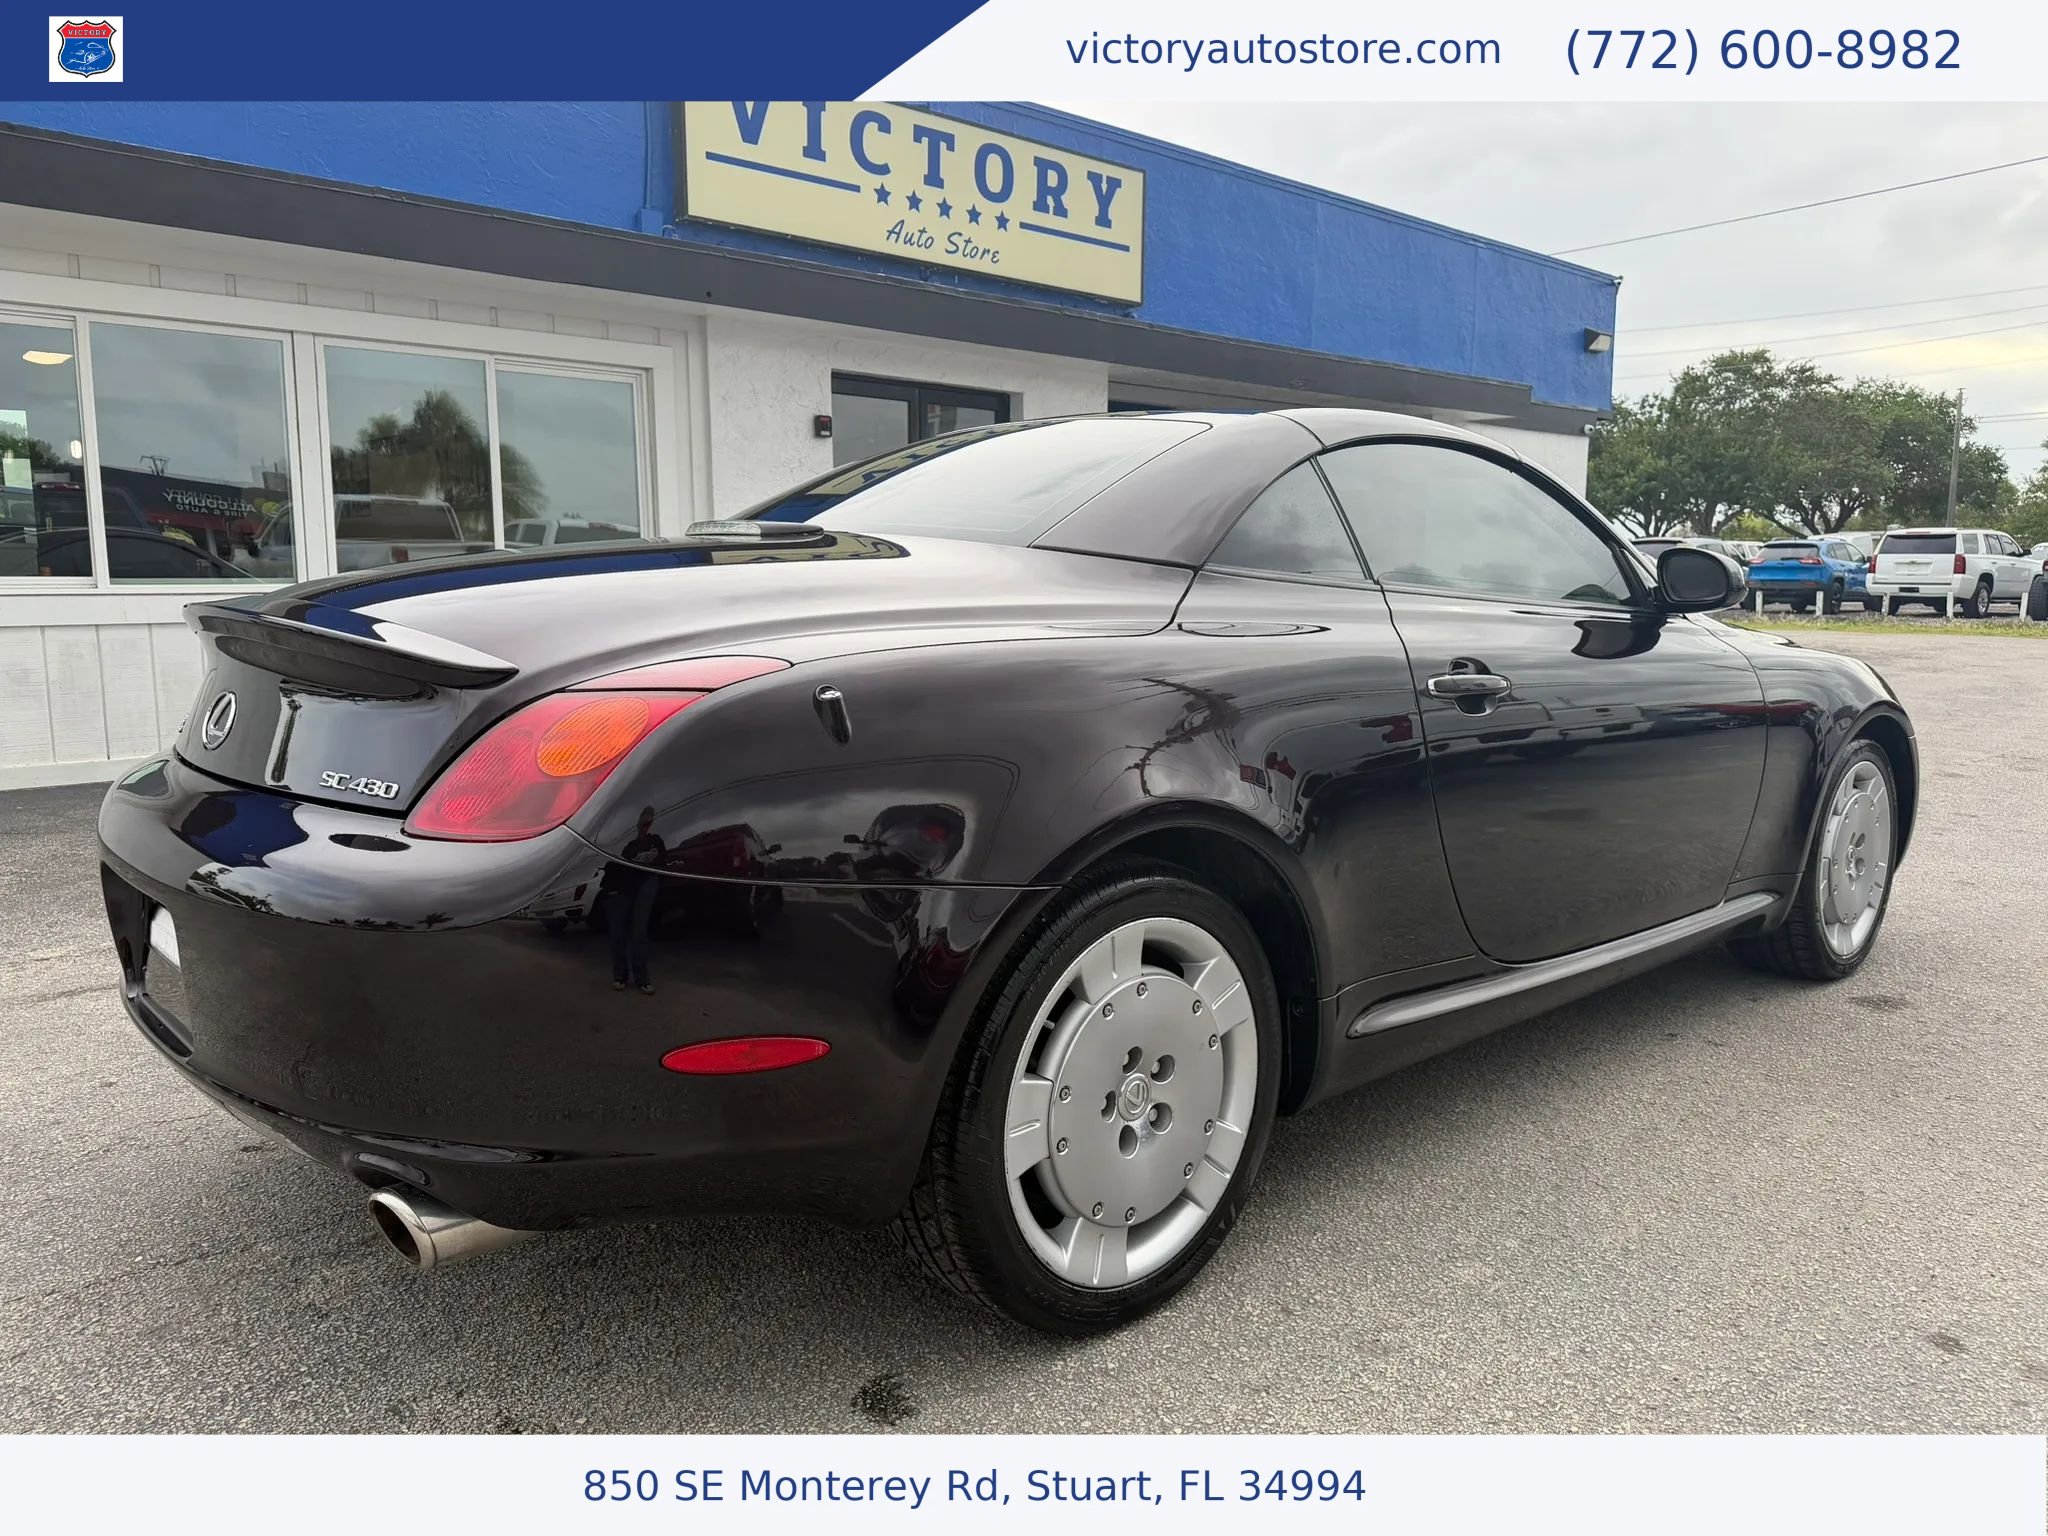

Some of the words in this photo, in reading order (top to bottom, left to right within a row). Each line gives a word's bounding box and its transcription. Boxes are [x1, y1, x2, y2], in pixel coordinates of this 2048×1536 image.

[730, 101, 1122, 230] VICTORY
[886, 219, 935, 249] Auto
[944, 231, 1000, 264] Store
